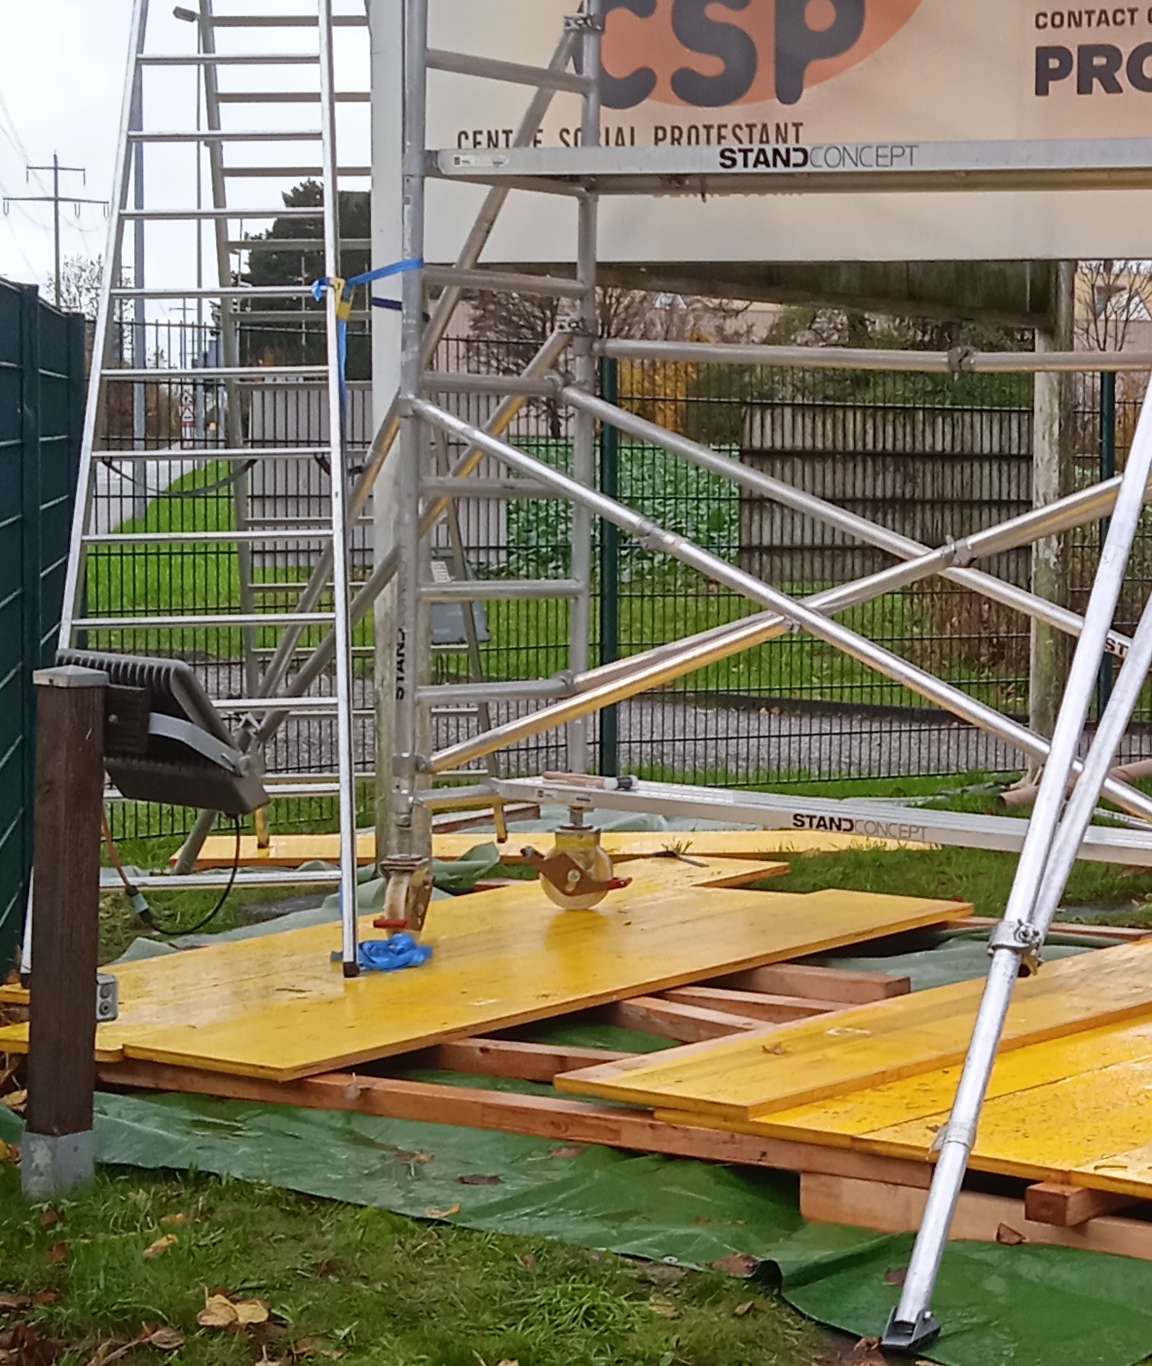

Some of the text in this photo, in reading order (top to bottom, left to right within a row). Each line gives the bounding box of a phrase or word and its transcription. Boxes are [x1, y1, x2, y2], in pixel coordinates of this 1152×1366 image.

[1034, 7, 1140, 30] CONTACT
[457, 128, 544, 150] CENTE
[558, 125, 637, 148] SOIAL
